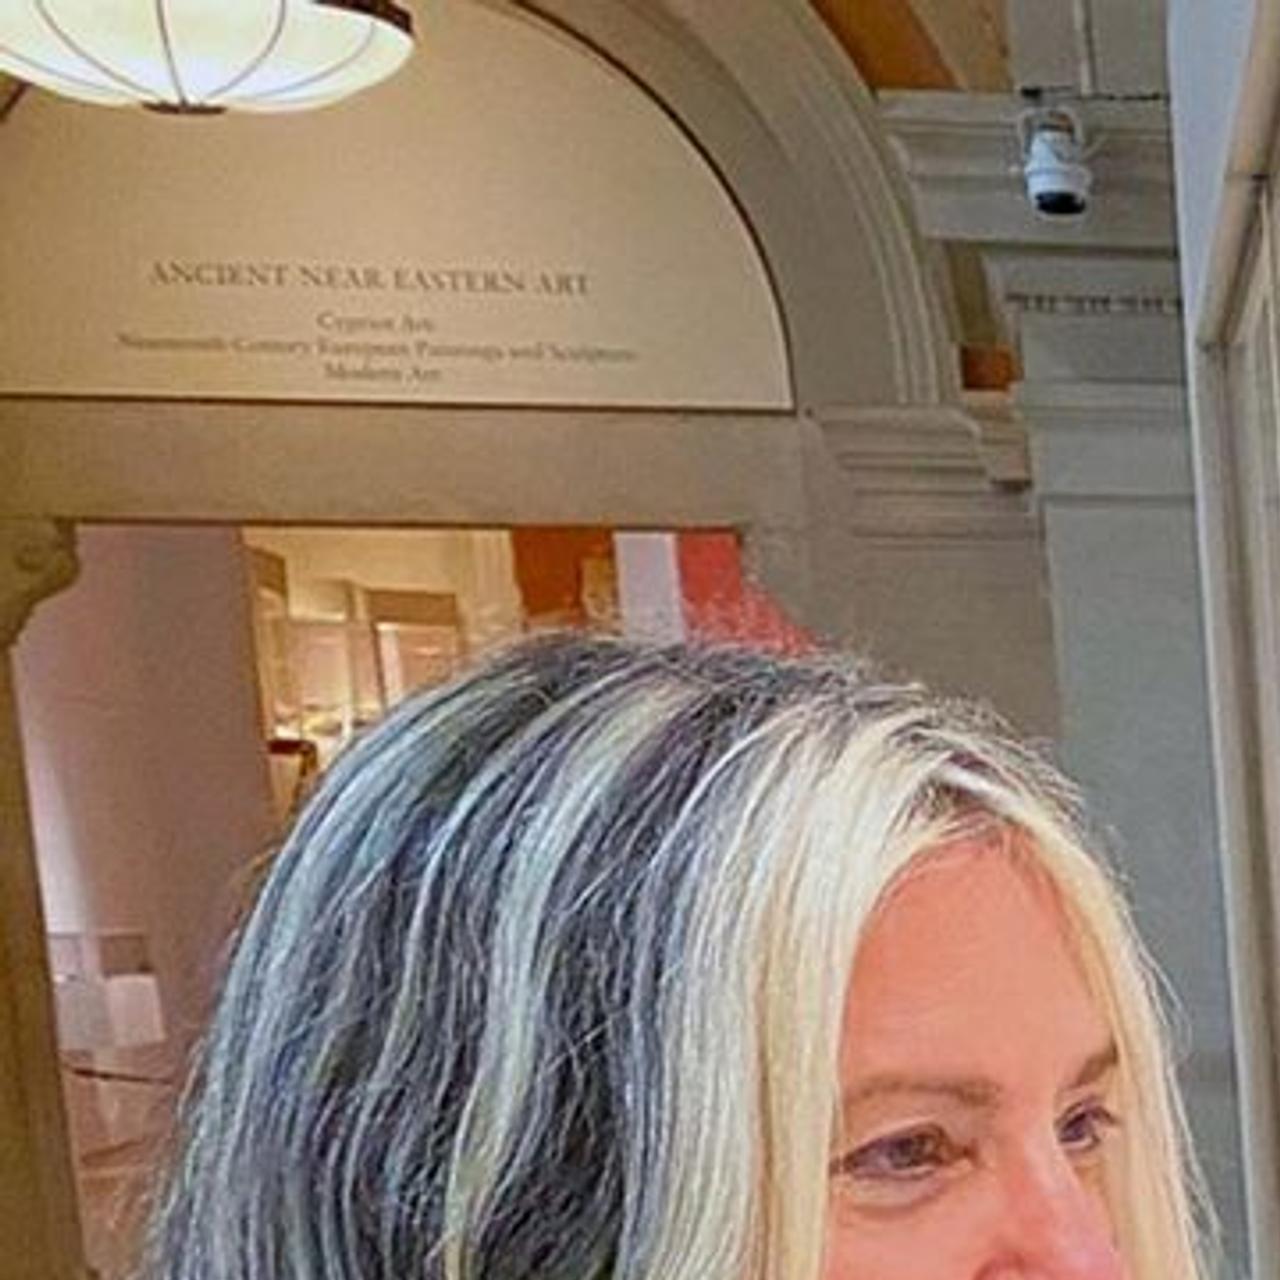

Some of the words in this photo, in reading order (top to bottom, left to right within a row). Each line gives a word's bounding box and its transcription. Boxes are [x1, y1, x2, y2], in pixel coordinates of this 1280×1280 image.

[149, 261, 288, 287] ANCIENT
[300, 264, 388, 290] NEAR
[394, 267, 526, 294] EASTERN
[534, 271, 589, 296] ART
[401, 312, 435, 333] Art
